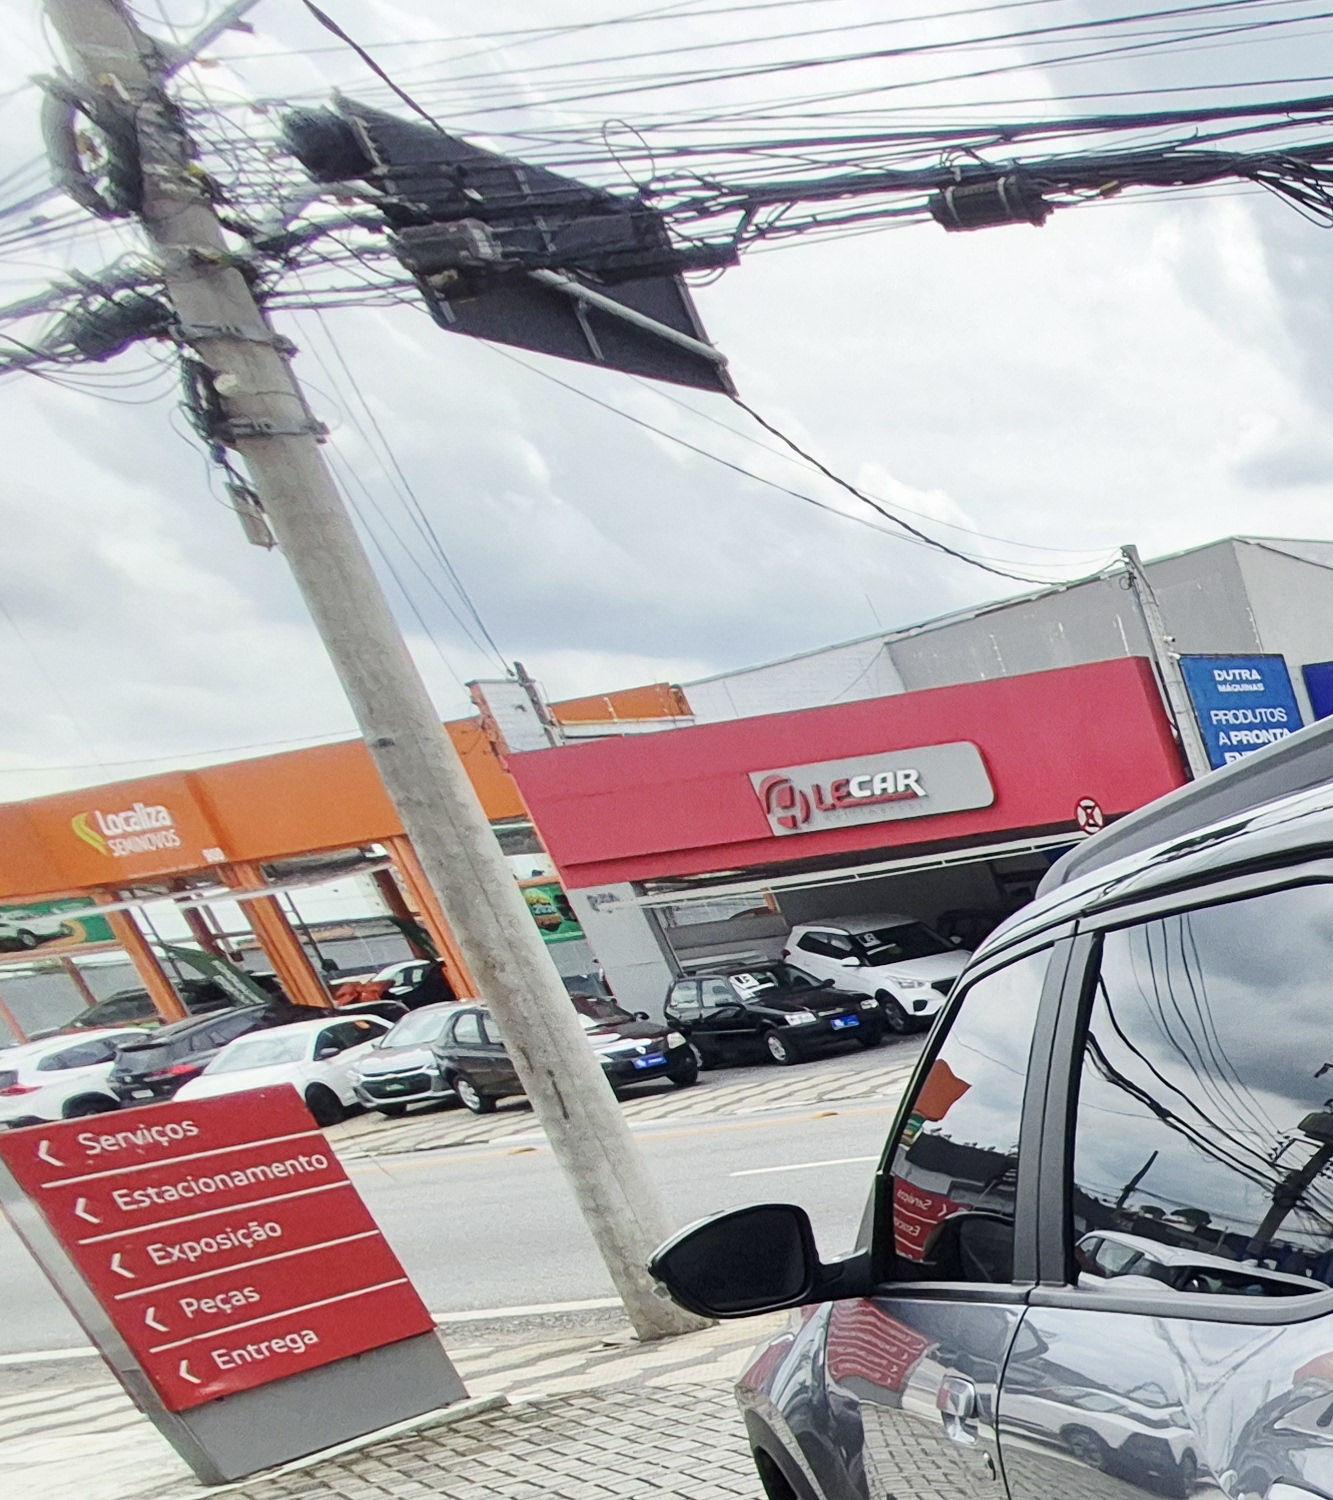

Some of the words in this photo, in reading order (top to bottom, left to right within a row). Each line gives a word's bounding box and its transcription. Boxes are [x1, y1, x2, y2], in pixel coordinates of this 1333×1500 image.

[1213, 669, 1262, 682] DUTRA
[1210, 707, 1288, 725] PRODUTOS
[1219, 731, 1231, 746] A
[95, 803, 173, 836] Localiza
[108, 829, 181, 857] SEMINOVOS
[77, 1117, 200, 1157] Serviços
[112, 1152, 328, 1212] Estacionamento
[147, 1218, 283, 1268] Exposição
[180, 1284, 261, 1322] Peças
[211, 1327, 319, 1372] Entrega
